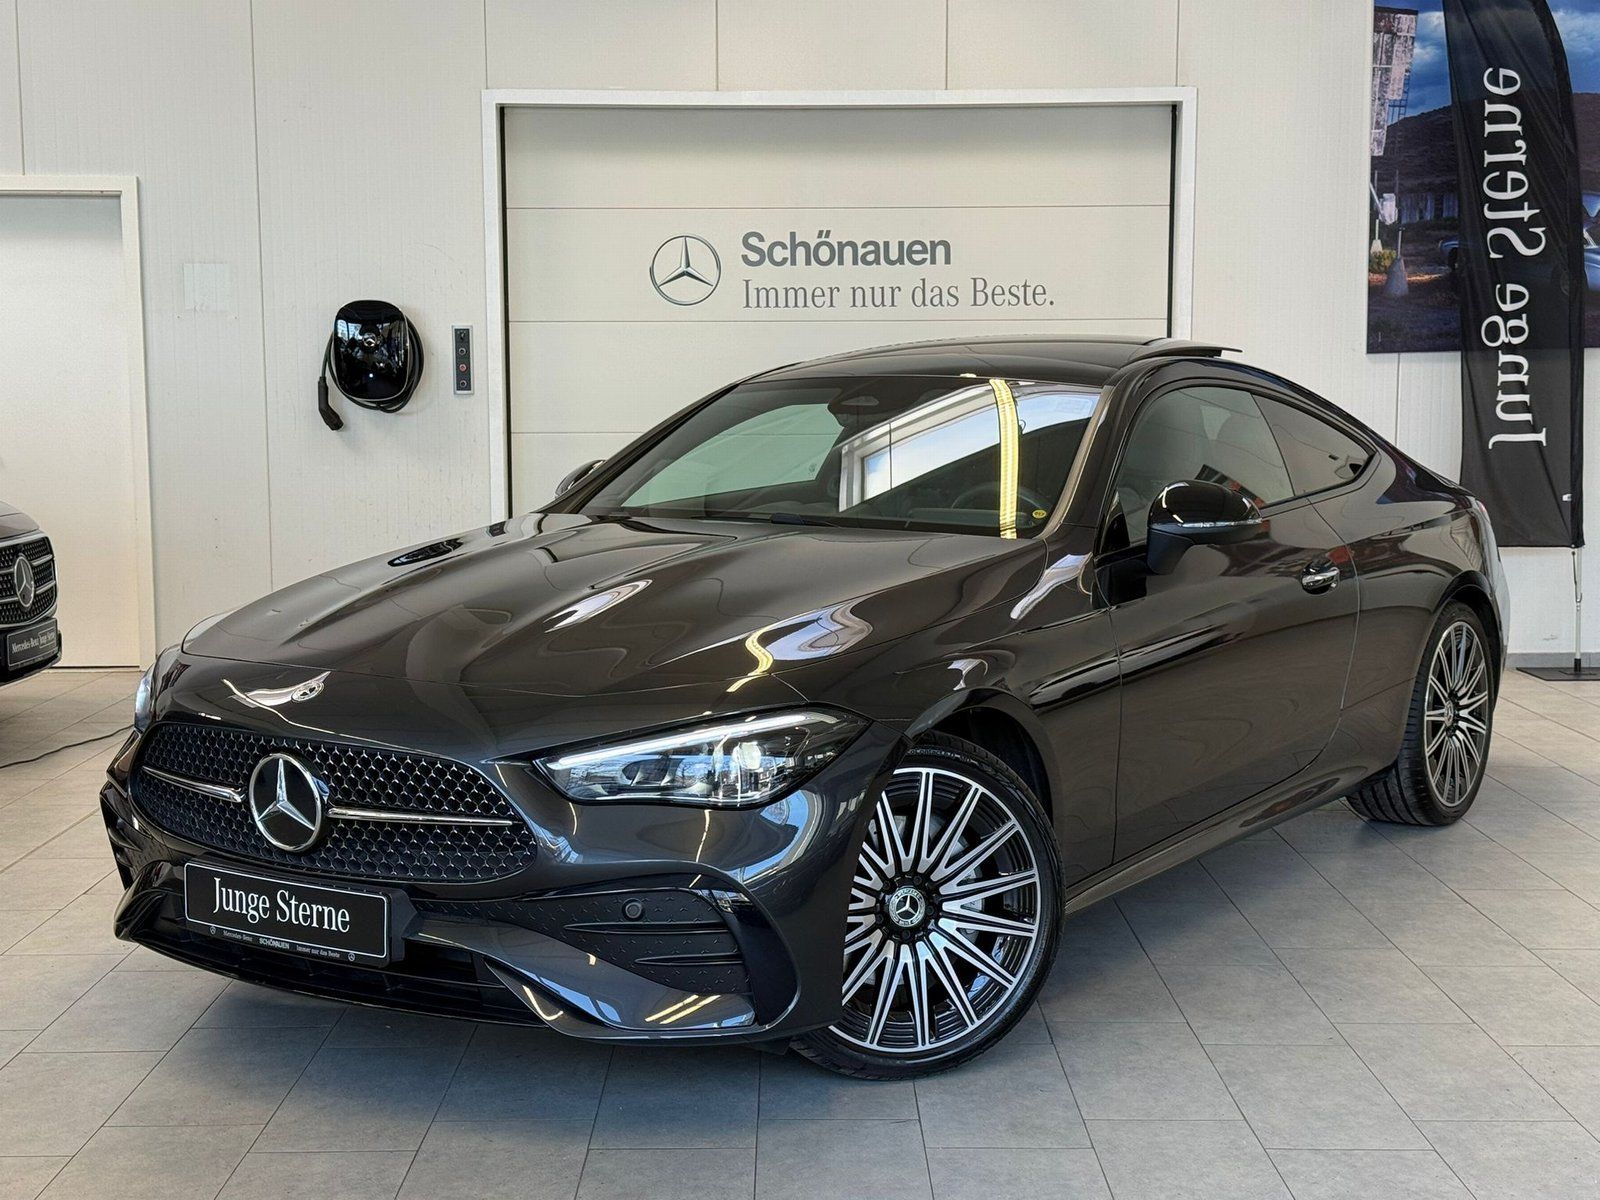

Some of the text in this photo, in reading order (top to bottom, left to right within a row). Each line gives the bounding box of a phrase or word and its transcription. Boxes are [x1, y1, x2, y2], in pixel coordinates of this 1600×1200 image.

[741, 229, 951, 267] Schönauen
[742, 276, 1055, 309] Immer nur das Beste.
[213, 877, 350, 933] Junge Sterne
